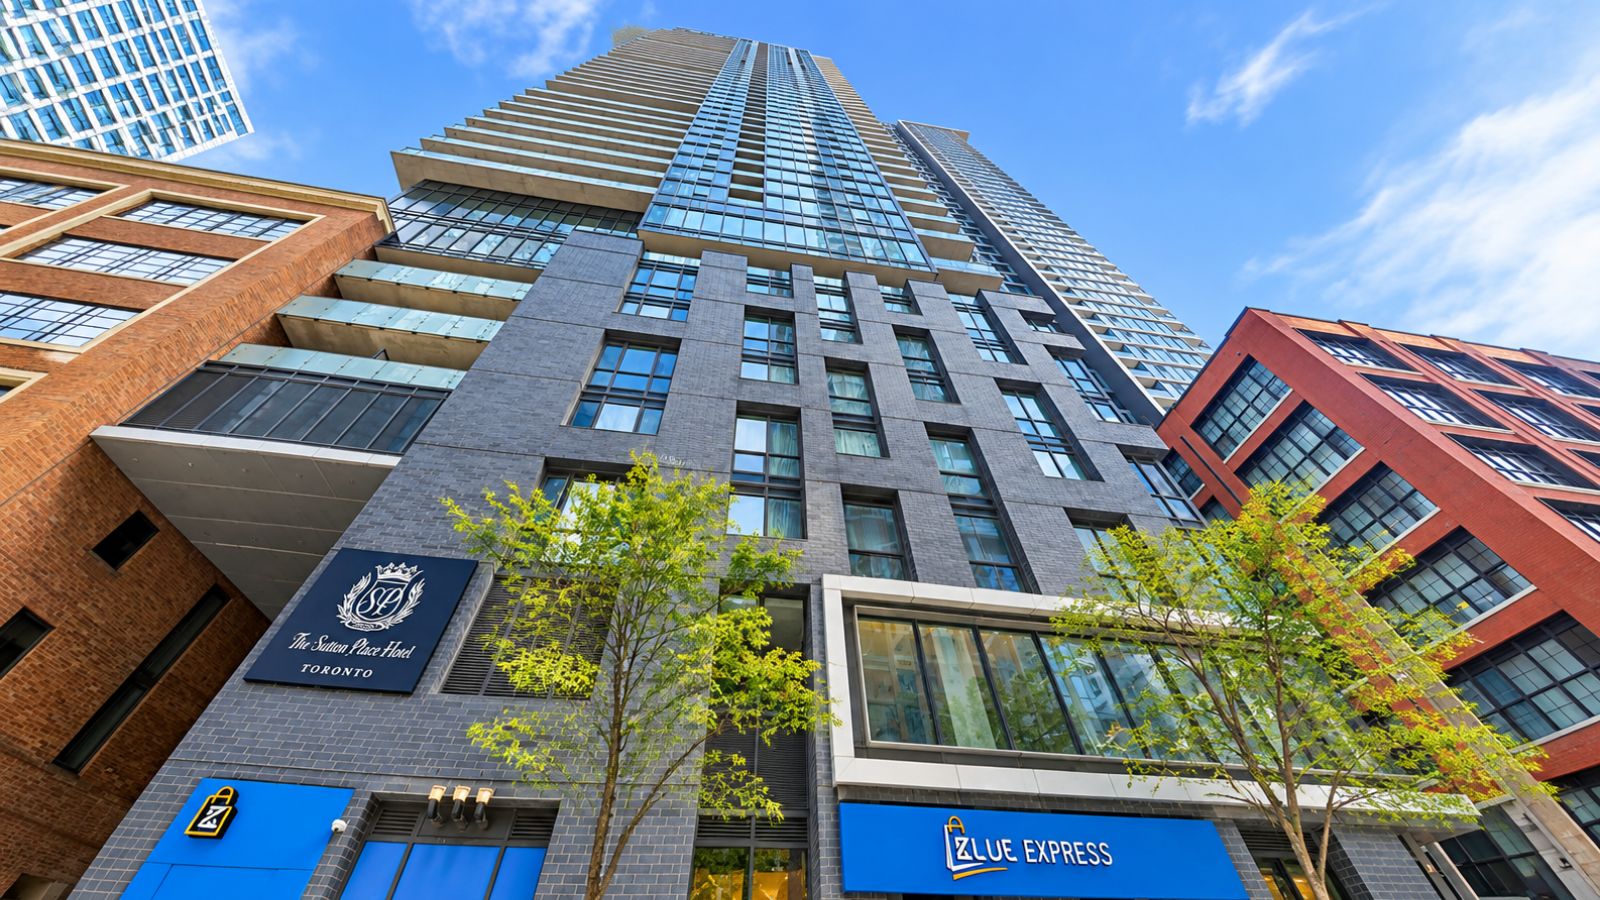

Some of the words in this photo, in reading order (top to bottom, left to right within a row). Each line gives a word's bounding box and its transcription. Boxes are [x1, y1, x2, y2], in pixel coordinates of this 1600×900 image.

[288, 632, 311, 650] The
[311, 635, 349, 654] Sutton
[345, 638, 381, 657] Place
[380, 641, 417, 659] Hotel
[301, 664, 373, 678] TORONTO
[1023, 839, 1113, 866] EXPRESS
